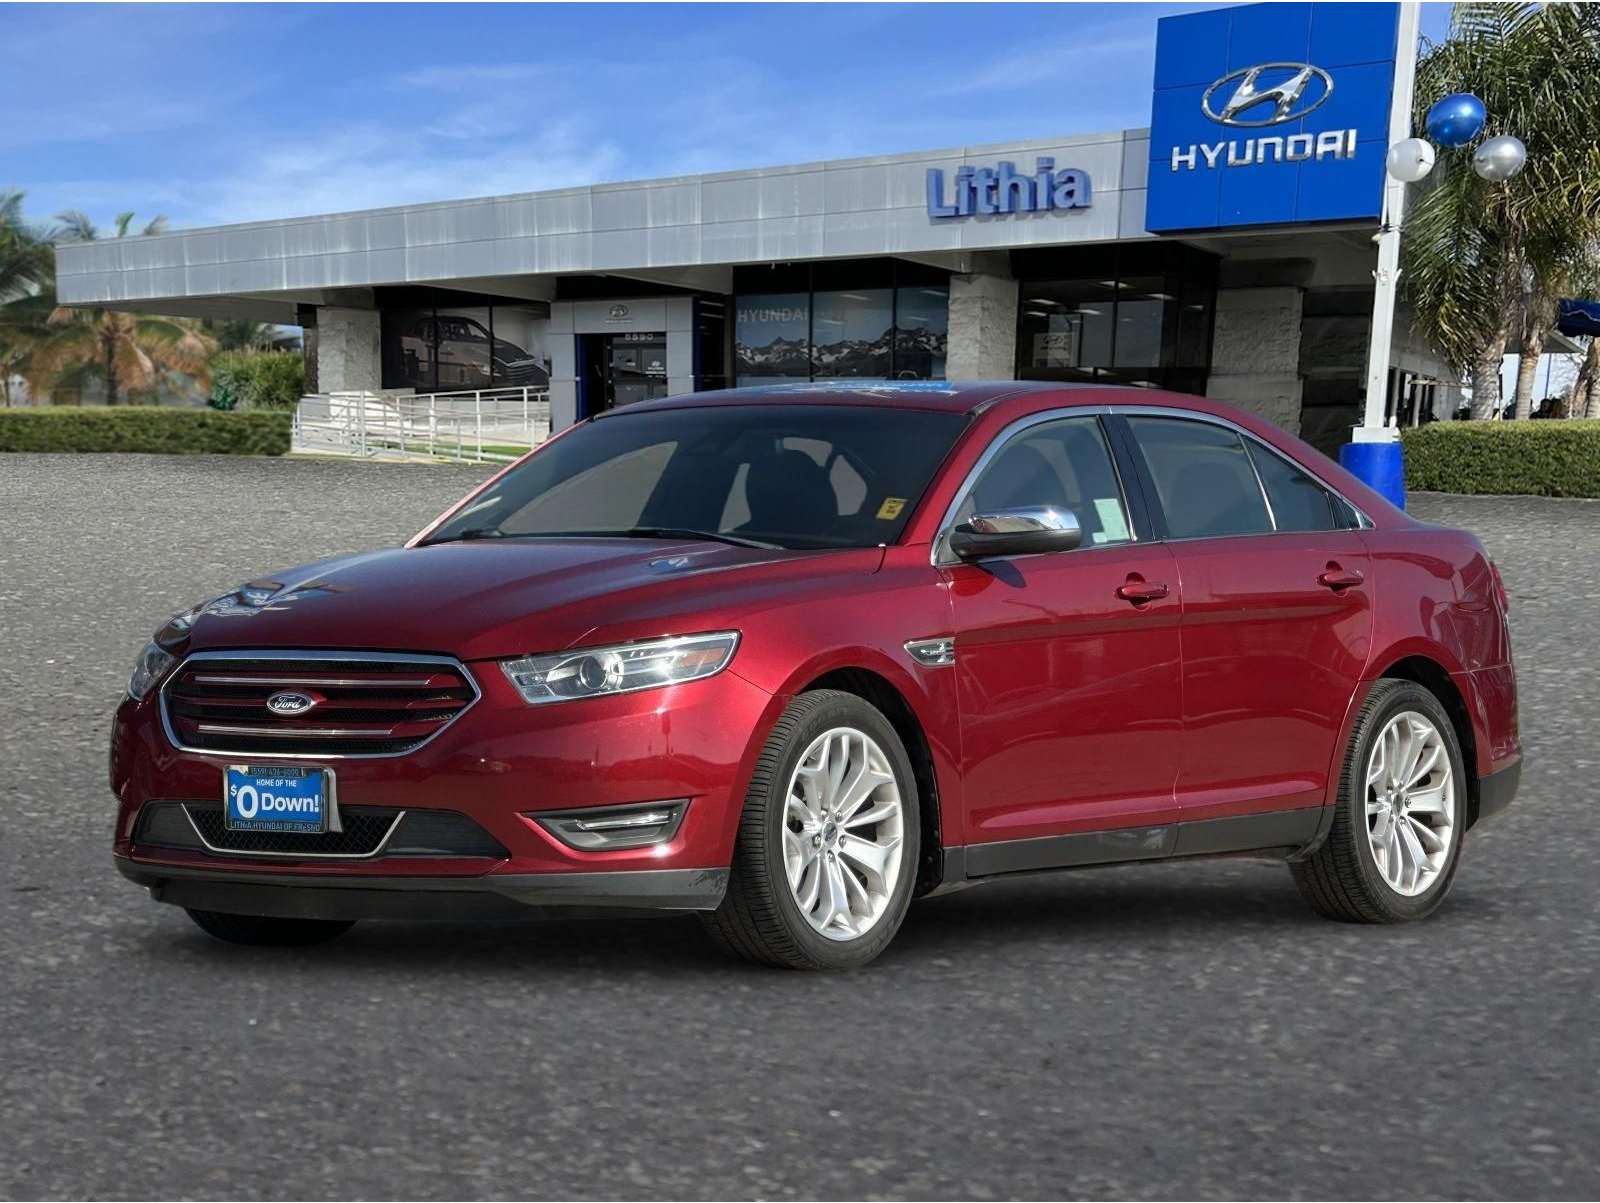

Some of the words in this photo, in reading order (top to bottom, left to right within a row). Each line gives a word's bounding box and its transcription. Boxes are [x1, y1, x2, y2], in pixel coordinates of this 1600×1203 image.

[1171, 129, 1357, 171] HYUNDAI
[927, 157, 1092, 219] Lithia
[737, 307, 809, 322] HYUNDAI
[256, 779, 274, 787] HOME
[275, 779, 284, 787] OF
[285, 779, 297, 788] THE
[261, 792, 319, 813] Down!
[230, 820, 252, 830] LITHIA
[253, 821, 283, 831] HYUNDAI
[284, 822, 293, 831] OF
